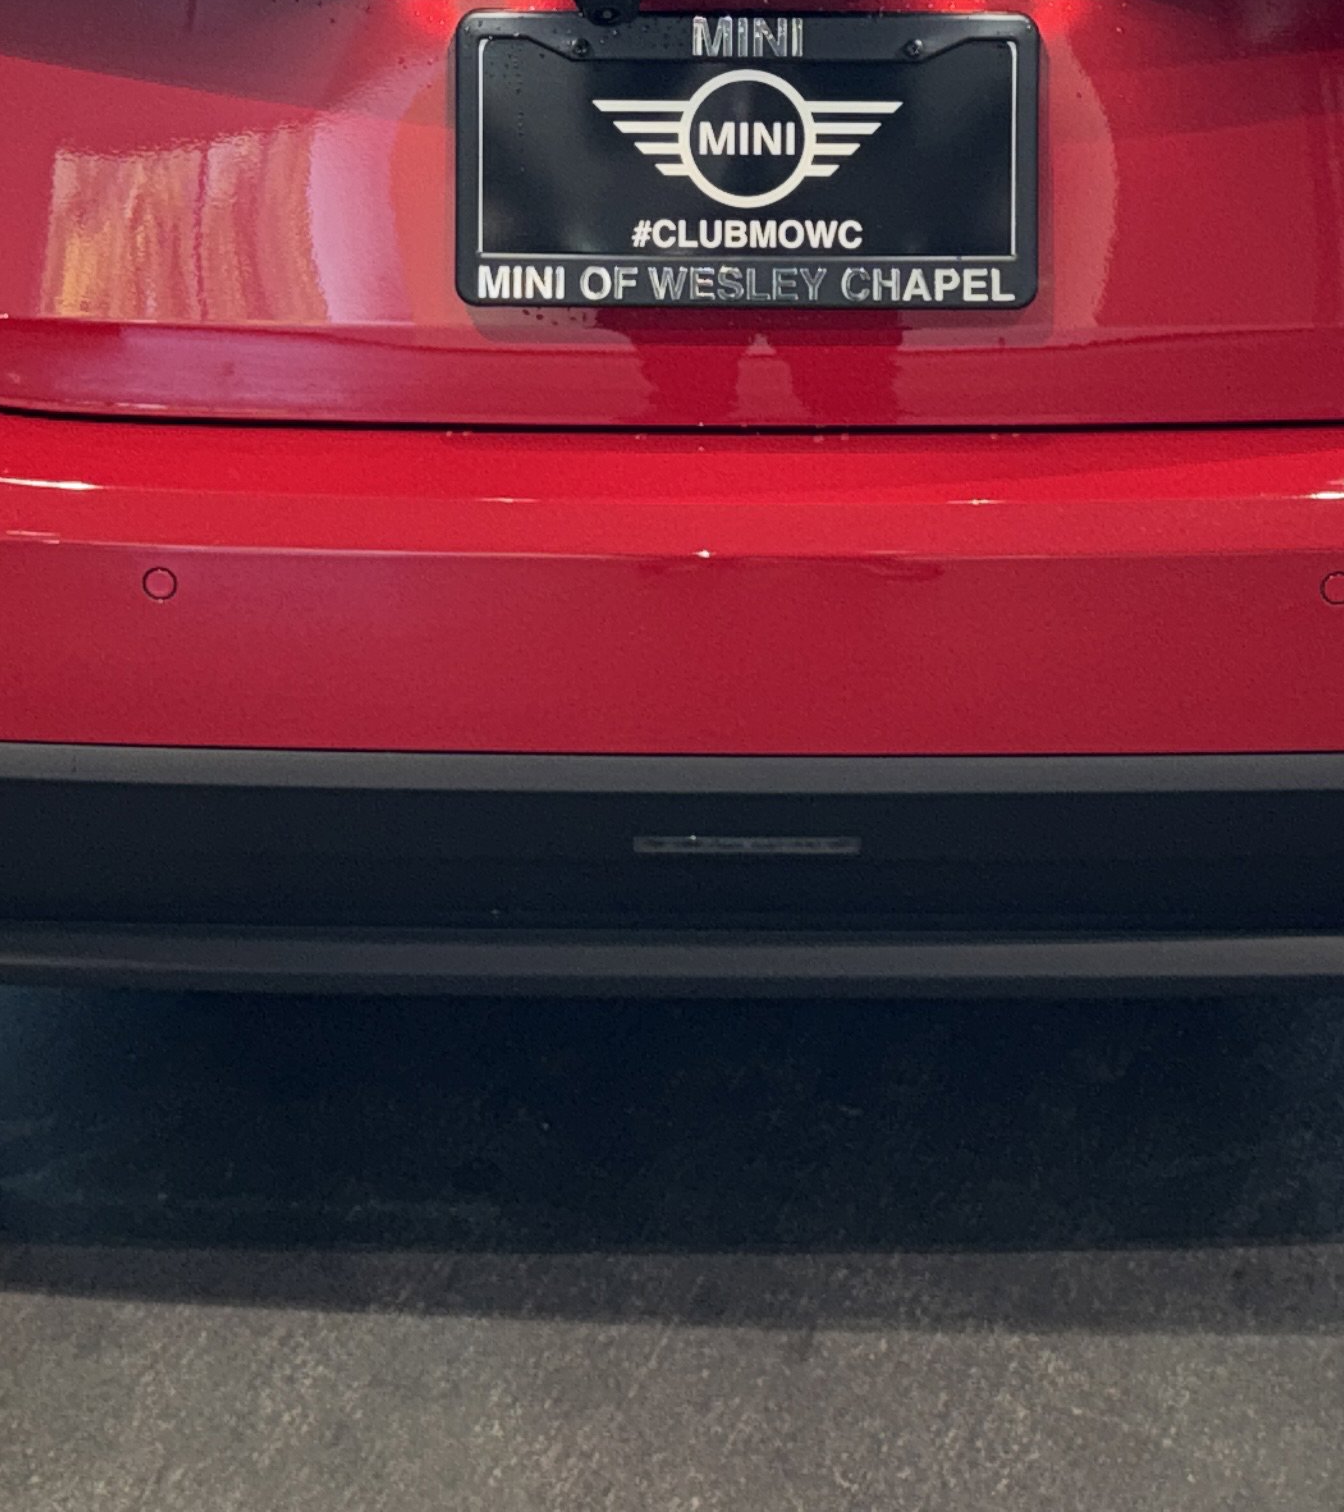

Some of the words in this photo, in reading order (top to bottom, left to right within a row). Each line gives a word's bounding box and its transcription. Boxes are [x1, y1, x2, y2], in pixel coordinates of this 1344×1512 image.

[692, 16, 804, 57] MINI
[698, 121, 796, 156] MINI
[631, 219, 863, 249] #CLUBMOWC
[477, 264, 565, 300] MINI
[580, 266, 637, 300] OF
[649, 266, 827, 301] WESLEY
[840, 267, 1016, 302] CHAPEL
